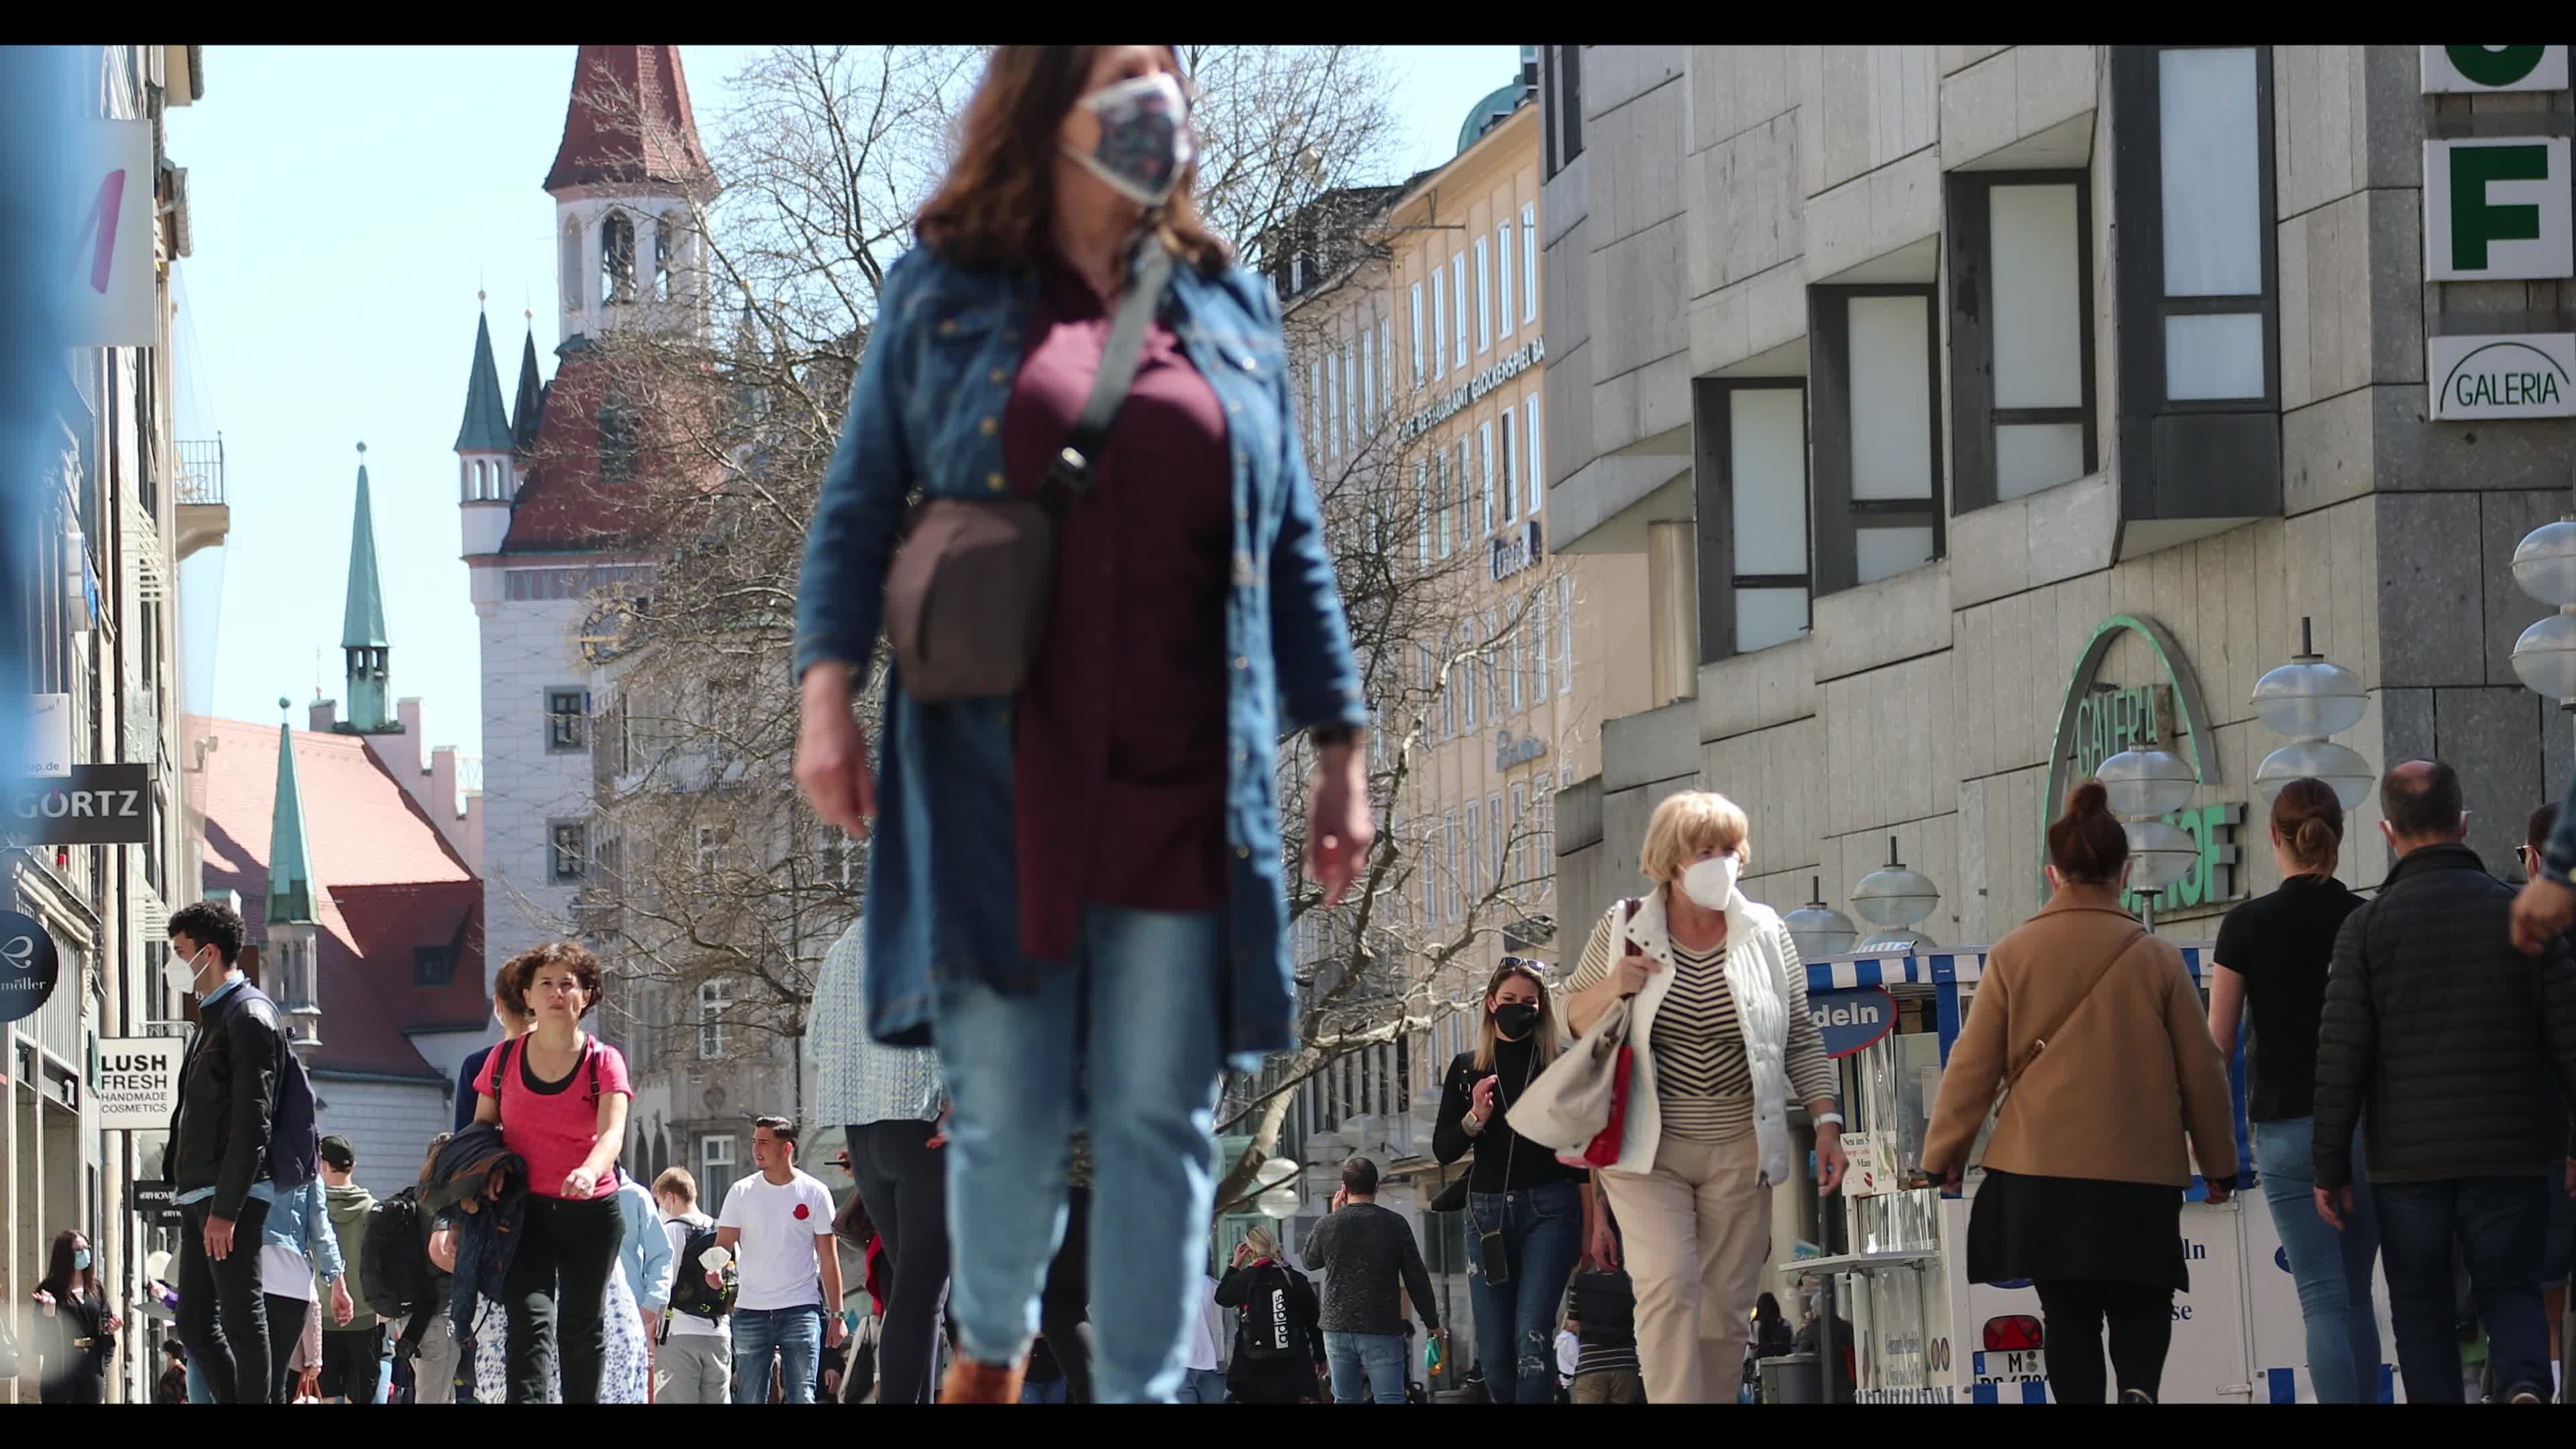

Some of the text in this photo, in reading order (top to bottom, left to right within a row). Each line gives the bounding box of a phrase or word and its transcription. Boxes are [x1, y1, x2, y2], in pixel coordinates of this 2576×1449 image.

[2456, 372, 2560, 407] GALERIA
[101, 1055, 166, 1071] LUSH
[101, 1075, 167, 1089] FRESH
[101, 1092, 167, 1102] HANDMADE
[101, 1104, 167, 1114] COSMETICS
[1273, 1294, 1289, 1344] adidas
[2008, 1352, 2022, 1373] M
